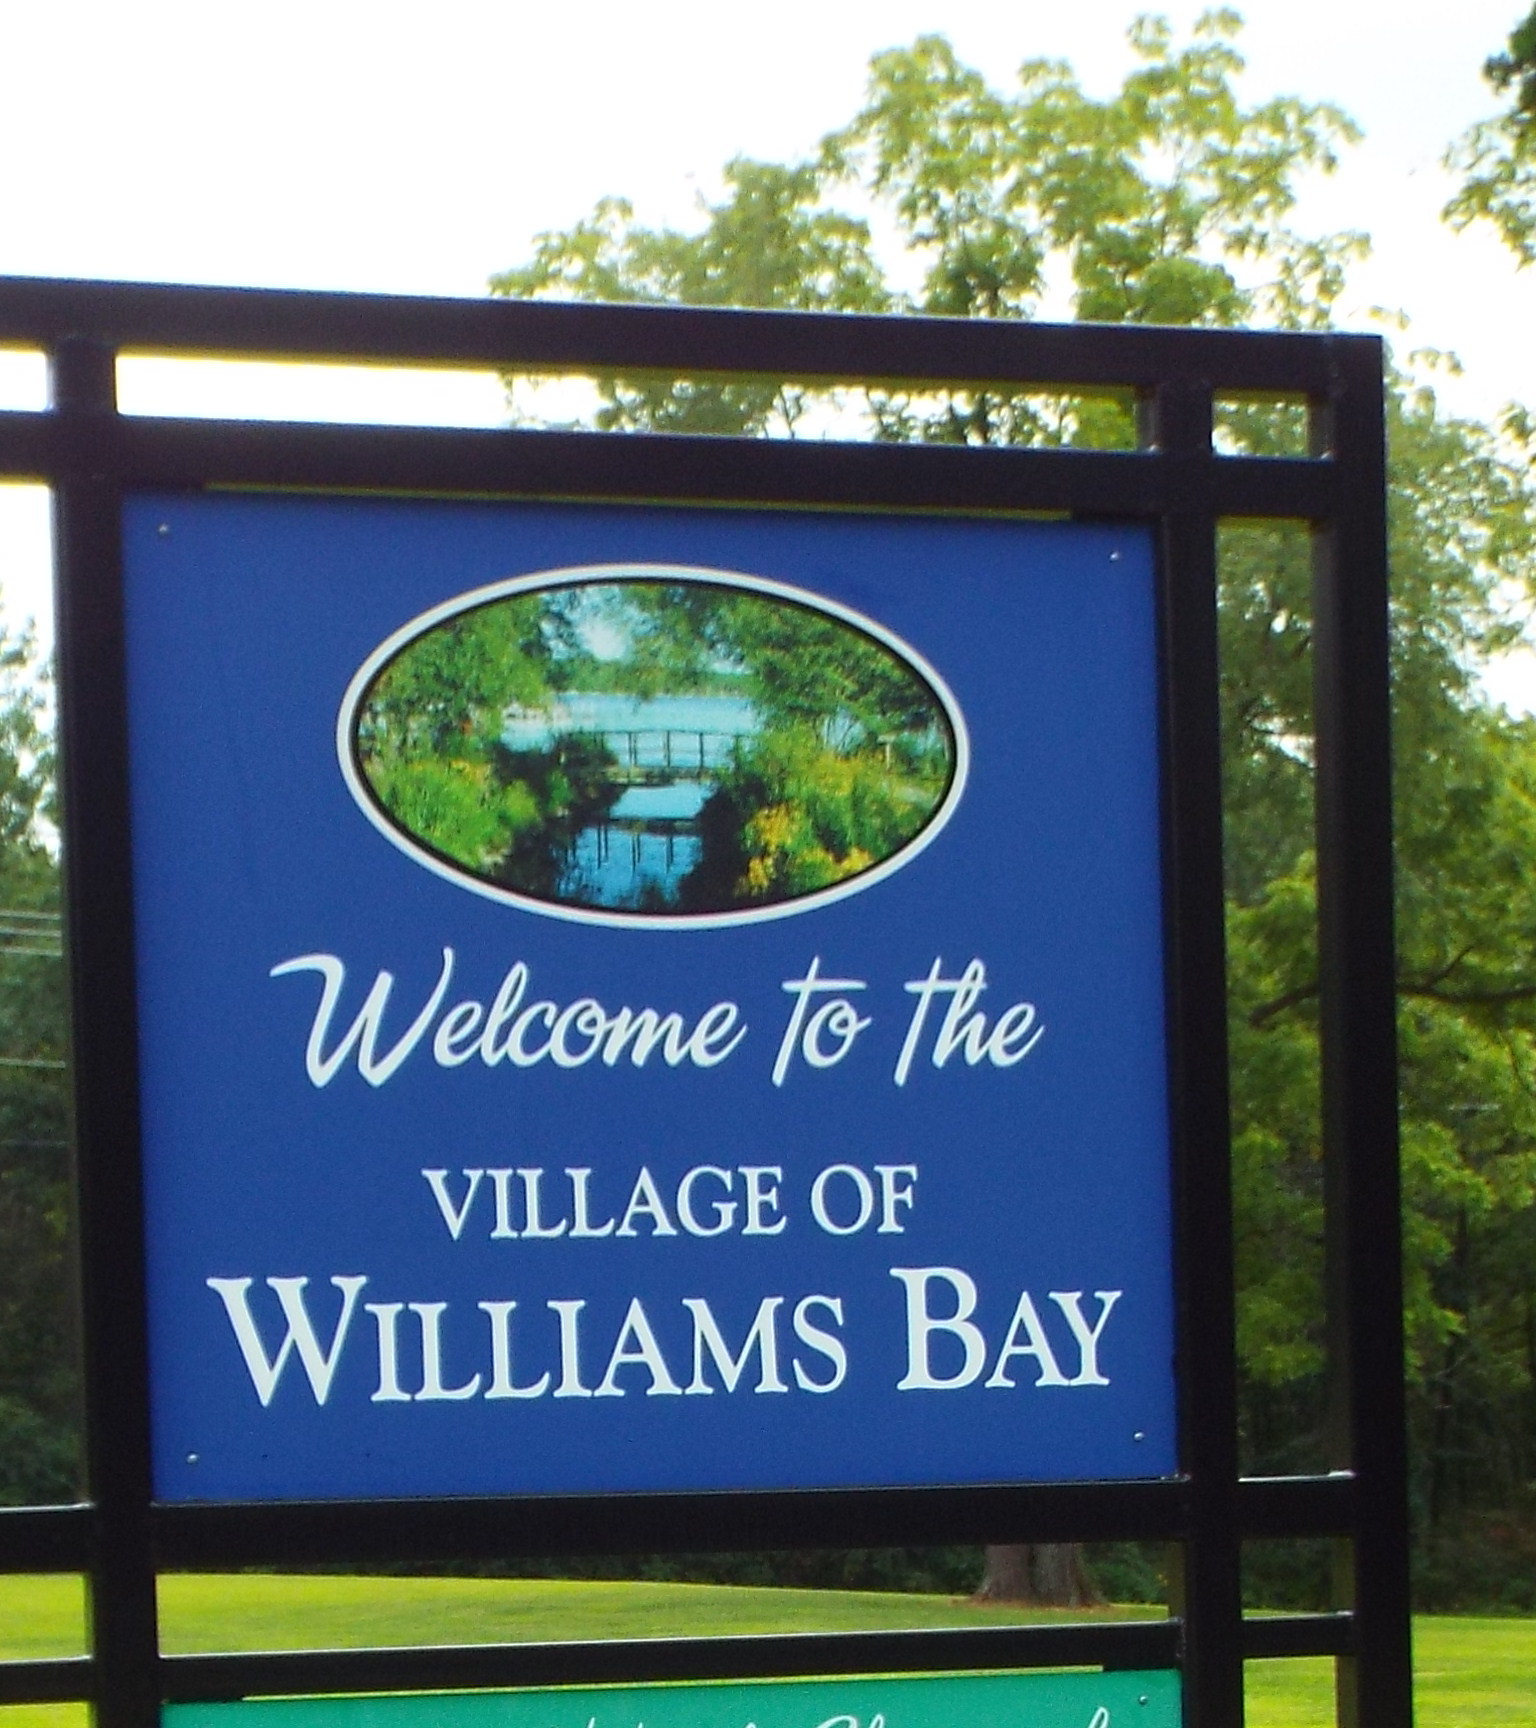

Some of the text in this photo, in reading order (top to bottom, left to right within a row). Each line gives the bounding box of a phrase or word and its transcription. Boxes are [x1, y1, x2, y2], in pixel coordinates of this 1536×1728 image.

[270, 946, 1044, 1087] Welcome to the
[421, 1164, 918, 1240] VILLAGE OF
[206, 1266, 1122, 1407] WILLIAMS BAY
